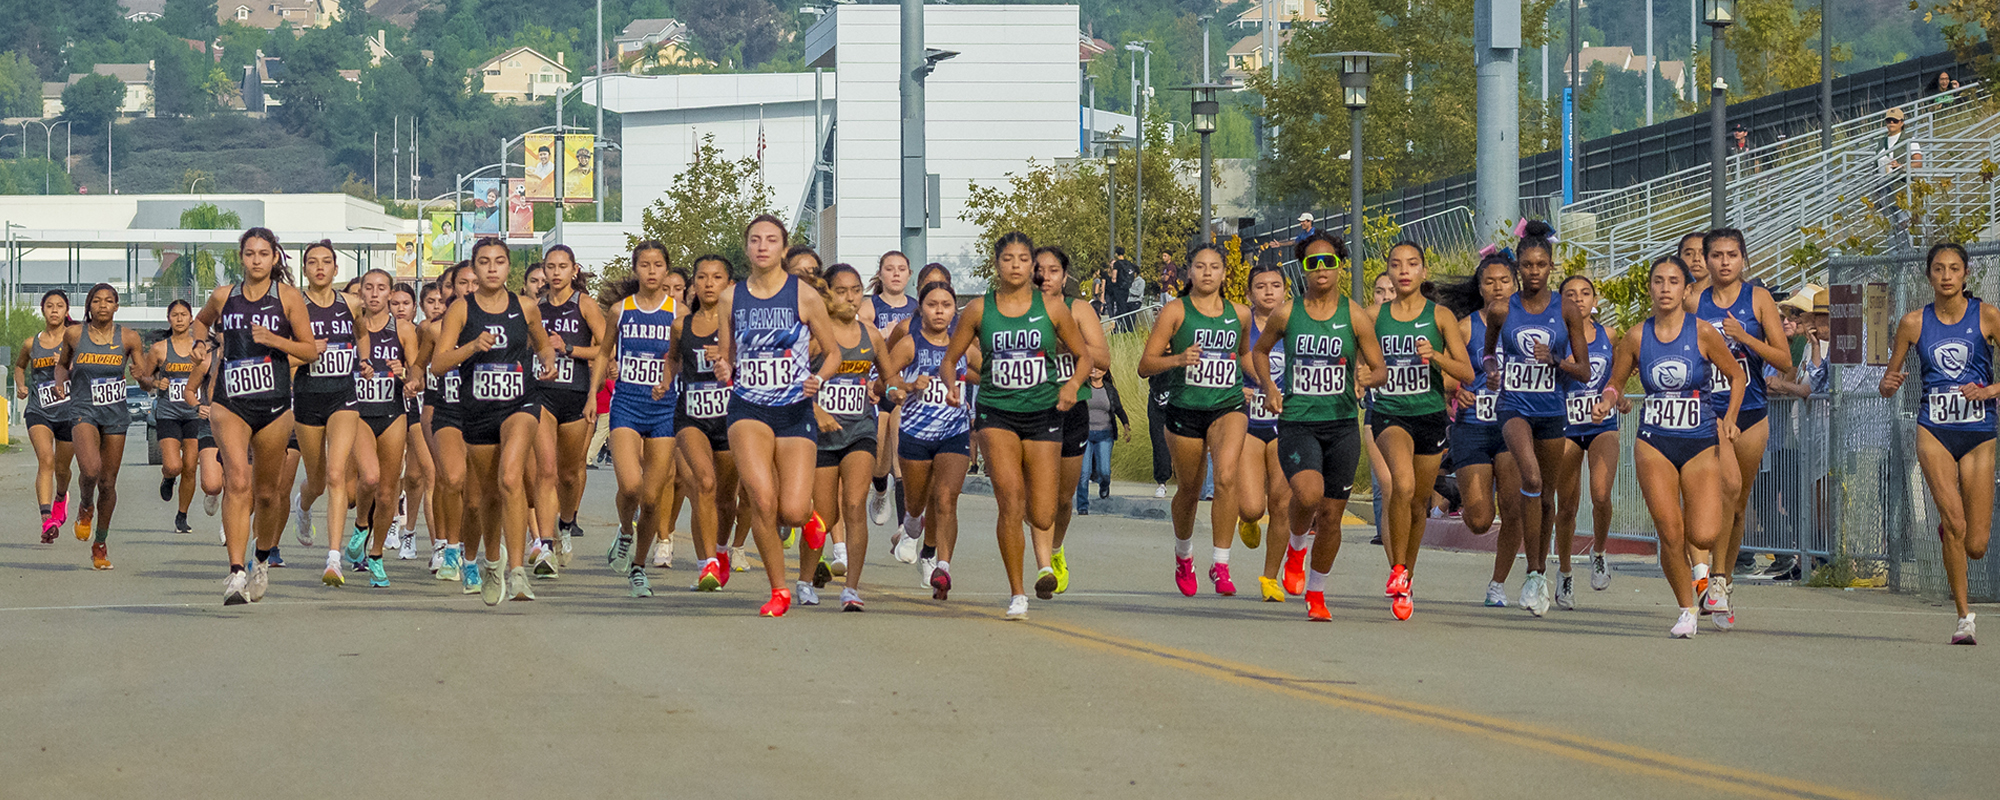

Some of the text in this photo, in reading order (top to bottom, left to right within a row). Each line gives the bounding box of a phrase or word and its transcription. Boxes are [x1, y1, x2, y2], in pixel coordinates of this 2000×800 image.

[223, 313, 280, 331] MT. SAC
[554, 318, 579, 333] SAC
[749, 307, 795, 331] CAMINO
[992, 328, 1042, 353] ELAC
[1194, 328, 1237, 350] ELAC
[1295, 334, 1343, 357] ELAC
[76, 352, 123, 366] LANCERS
[316, 350, 353, 374] 3607
[373, 345, 398, 360] SAC
[230, 364, 273, 394] 3608
[480, 372, 522, 398] 3535
[747, 359, 791, 387] 3513
[999, 359, 1045, 387] 3497
[1192, 360, 1235, 386] 3492
[1300, 366, 1344, 393] 3493
[1386, 365, 1429, 393] 3495
[1512, 364, 1554, 390] 3473
[97, 380, 126, 404] 3632
[357, 378, 394, 401] 3612
[826, 385, 864, 412] 3636
[1652, 399, 1699, 427] 3476
[1936, 393, 1984, 422] 3479
